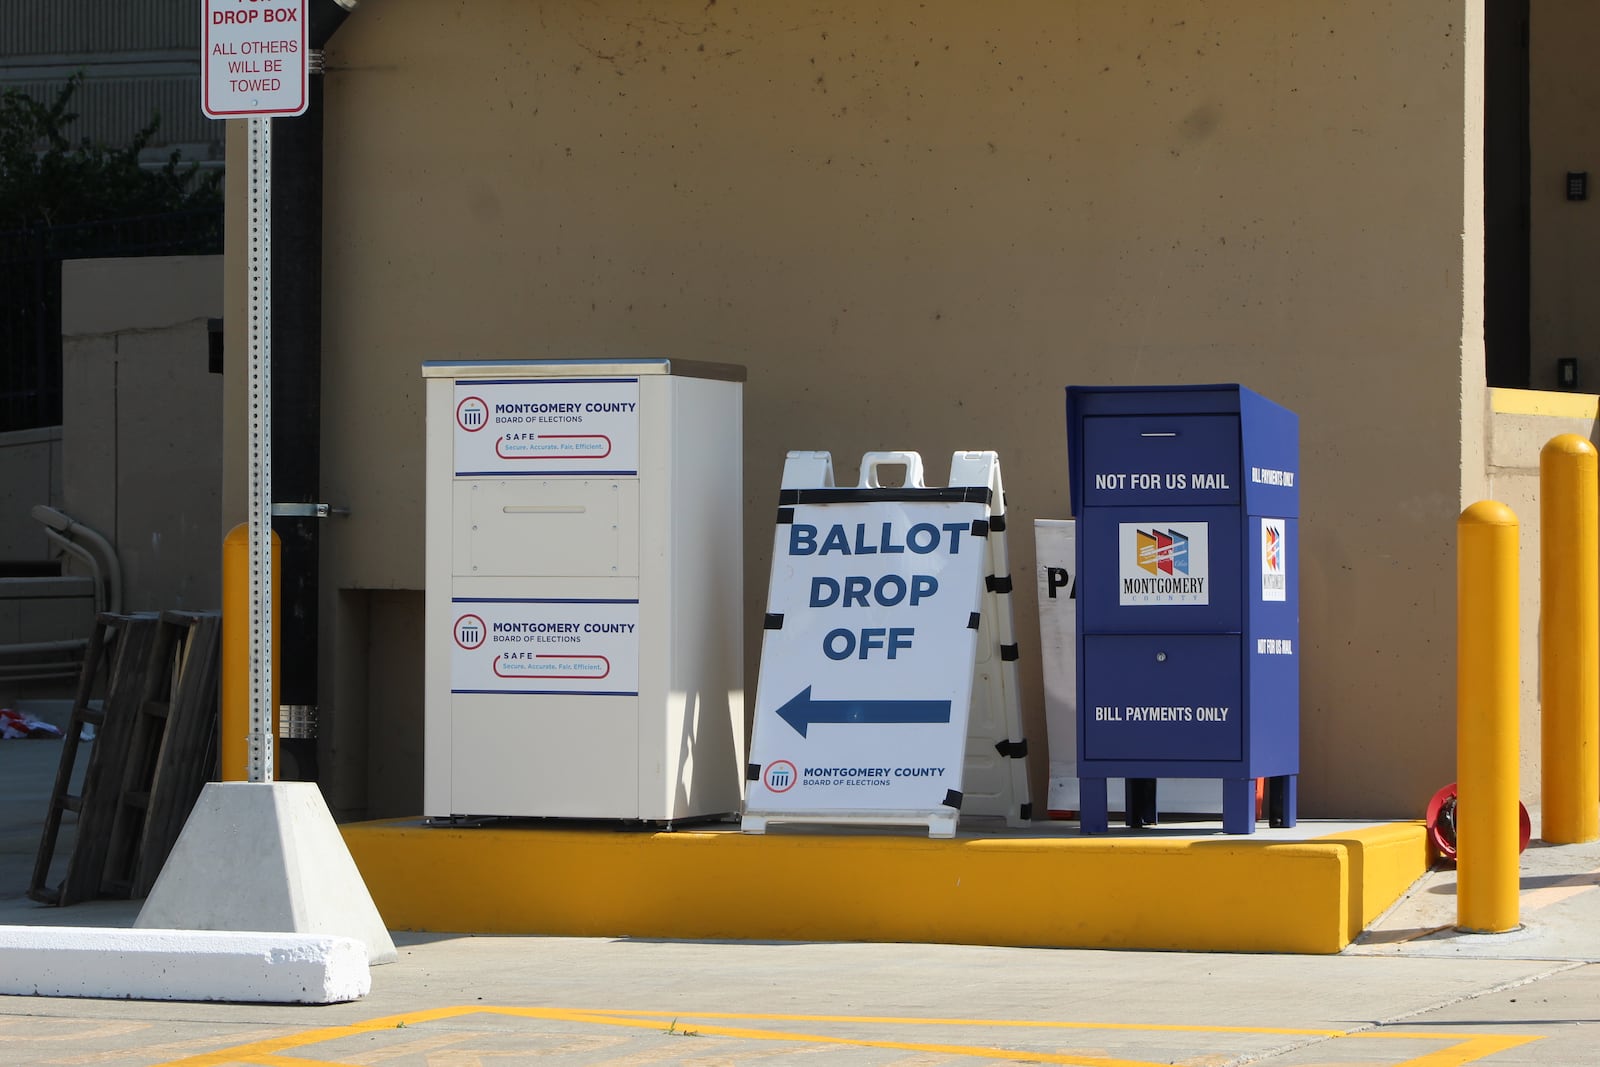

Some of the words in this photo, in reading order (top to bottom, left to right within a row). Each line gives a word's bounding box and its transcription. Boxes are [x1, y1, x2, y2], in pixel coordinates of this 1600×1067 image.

[213, 10, 258, 25] DROP
[264, 8, 297, 23] BOX
[213, 42, 237, 56] ALL
[241, 40, 298, 55] OTHERS
[228, 61, 260, 74] WILL
[264, 59, 282, 72] BE
[229, 78, 281, 92] TOWED
[495, 403, 582, 414] MONTGOMERY
[585, 402, 636, 413] COUNTY
[495, 416, 523, 424] BOARD
[538, 415, 583, 423] ELECTIONS
[505, 433, 535, 441] SAFE
[1095, 473, 1127, 490] NOT
[1130, 473, 1161, 490] FOR
[1165, 473, 1187, 490] US
[1191, 473, 1230, 489] MAIL
[788, 522, 970, 556] BALLOT
[809, 574, 939, 608] DROP
[1123, 577, 1204, 594] MONTGOMERY
[493, 622, 580, 633] MONTGOMERY
[583, 623, 635, 633] COUNTY
[493, 635, 522, 643] BOARD
[523, 635, 535, 643] OF
[537, 635, 581, 643] ELECTIONS
[822, 627, 915, 661] OFF
[503, 652, 533, 660] SAFE
[1095, 707, 1122, 721] BILL
[1125, 707, 1193, 721] PAYMENTS
[1196, 707, 1229, 722] ONLY
[803, 767, 891, 778] MONTGOMERY
[894, 767, 946, 777] COUNTY
[803, 779, 831, 787] BOARD
[833, 779, 845, 787] OF
[846, 779, 891, 787] ELECTIONS
